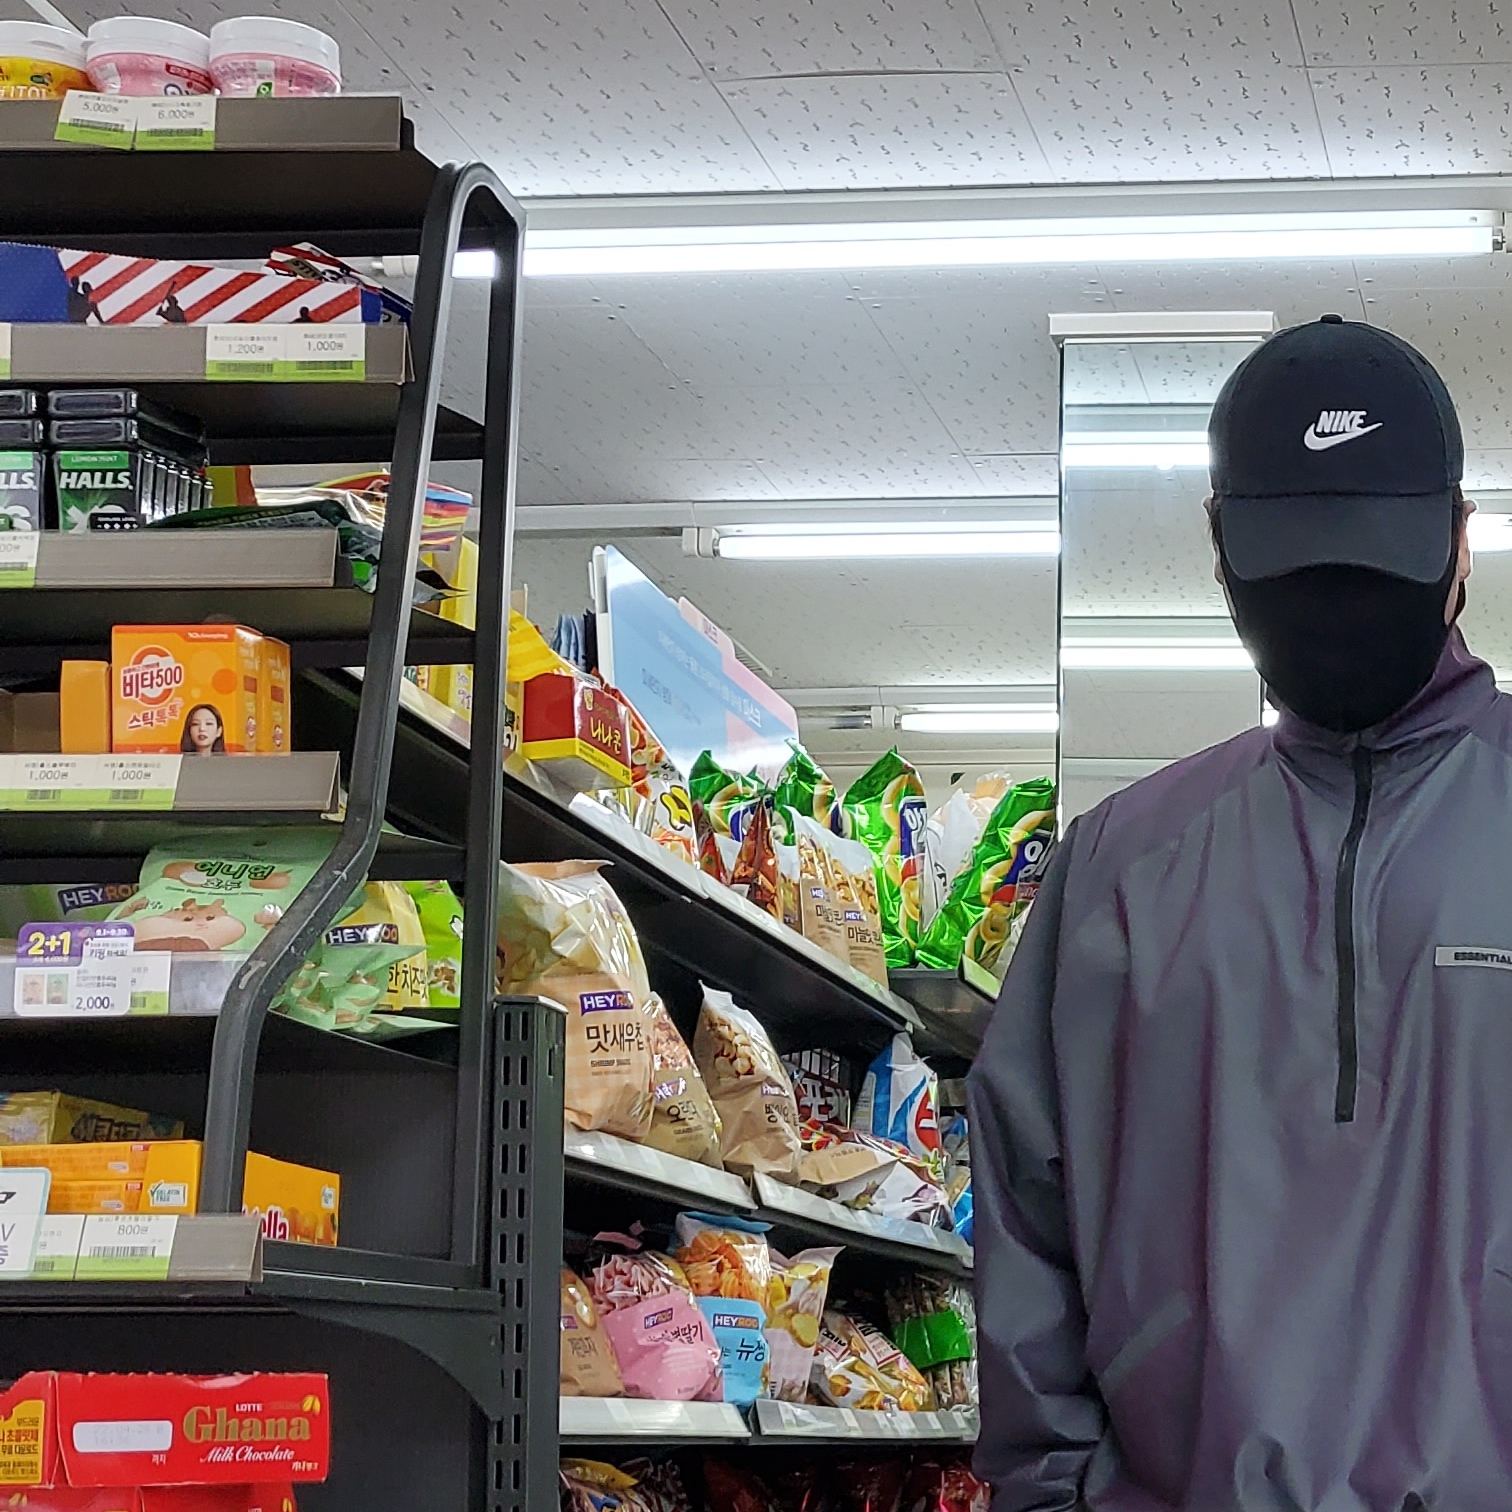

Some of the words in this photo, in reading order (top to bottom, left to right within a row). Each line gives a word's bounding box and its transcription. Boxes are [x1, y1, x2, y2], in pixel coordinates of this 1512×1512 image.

[1316, 411, 1367, 432] NIKE
[122, 665, 183, 698] 비타500
[195, 861, 276, 881] 어니언
[28, 931, 71, 955] 2+1
[235, 1403, 262, 1411] LOTTE
[183, 1406, 311, 1444] Ghana
[200, 1446, 233, 1463] Milk
[235, 1446, 294, 1461] Chocolate
